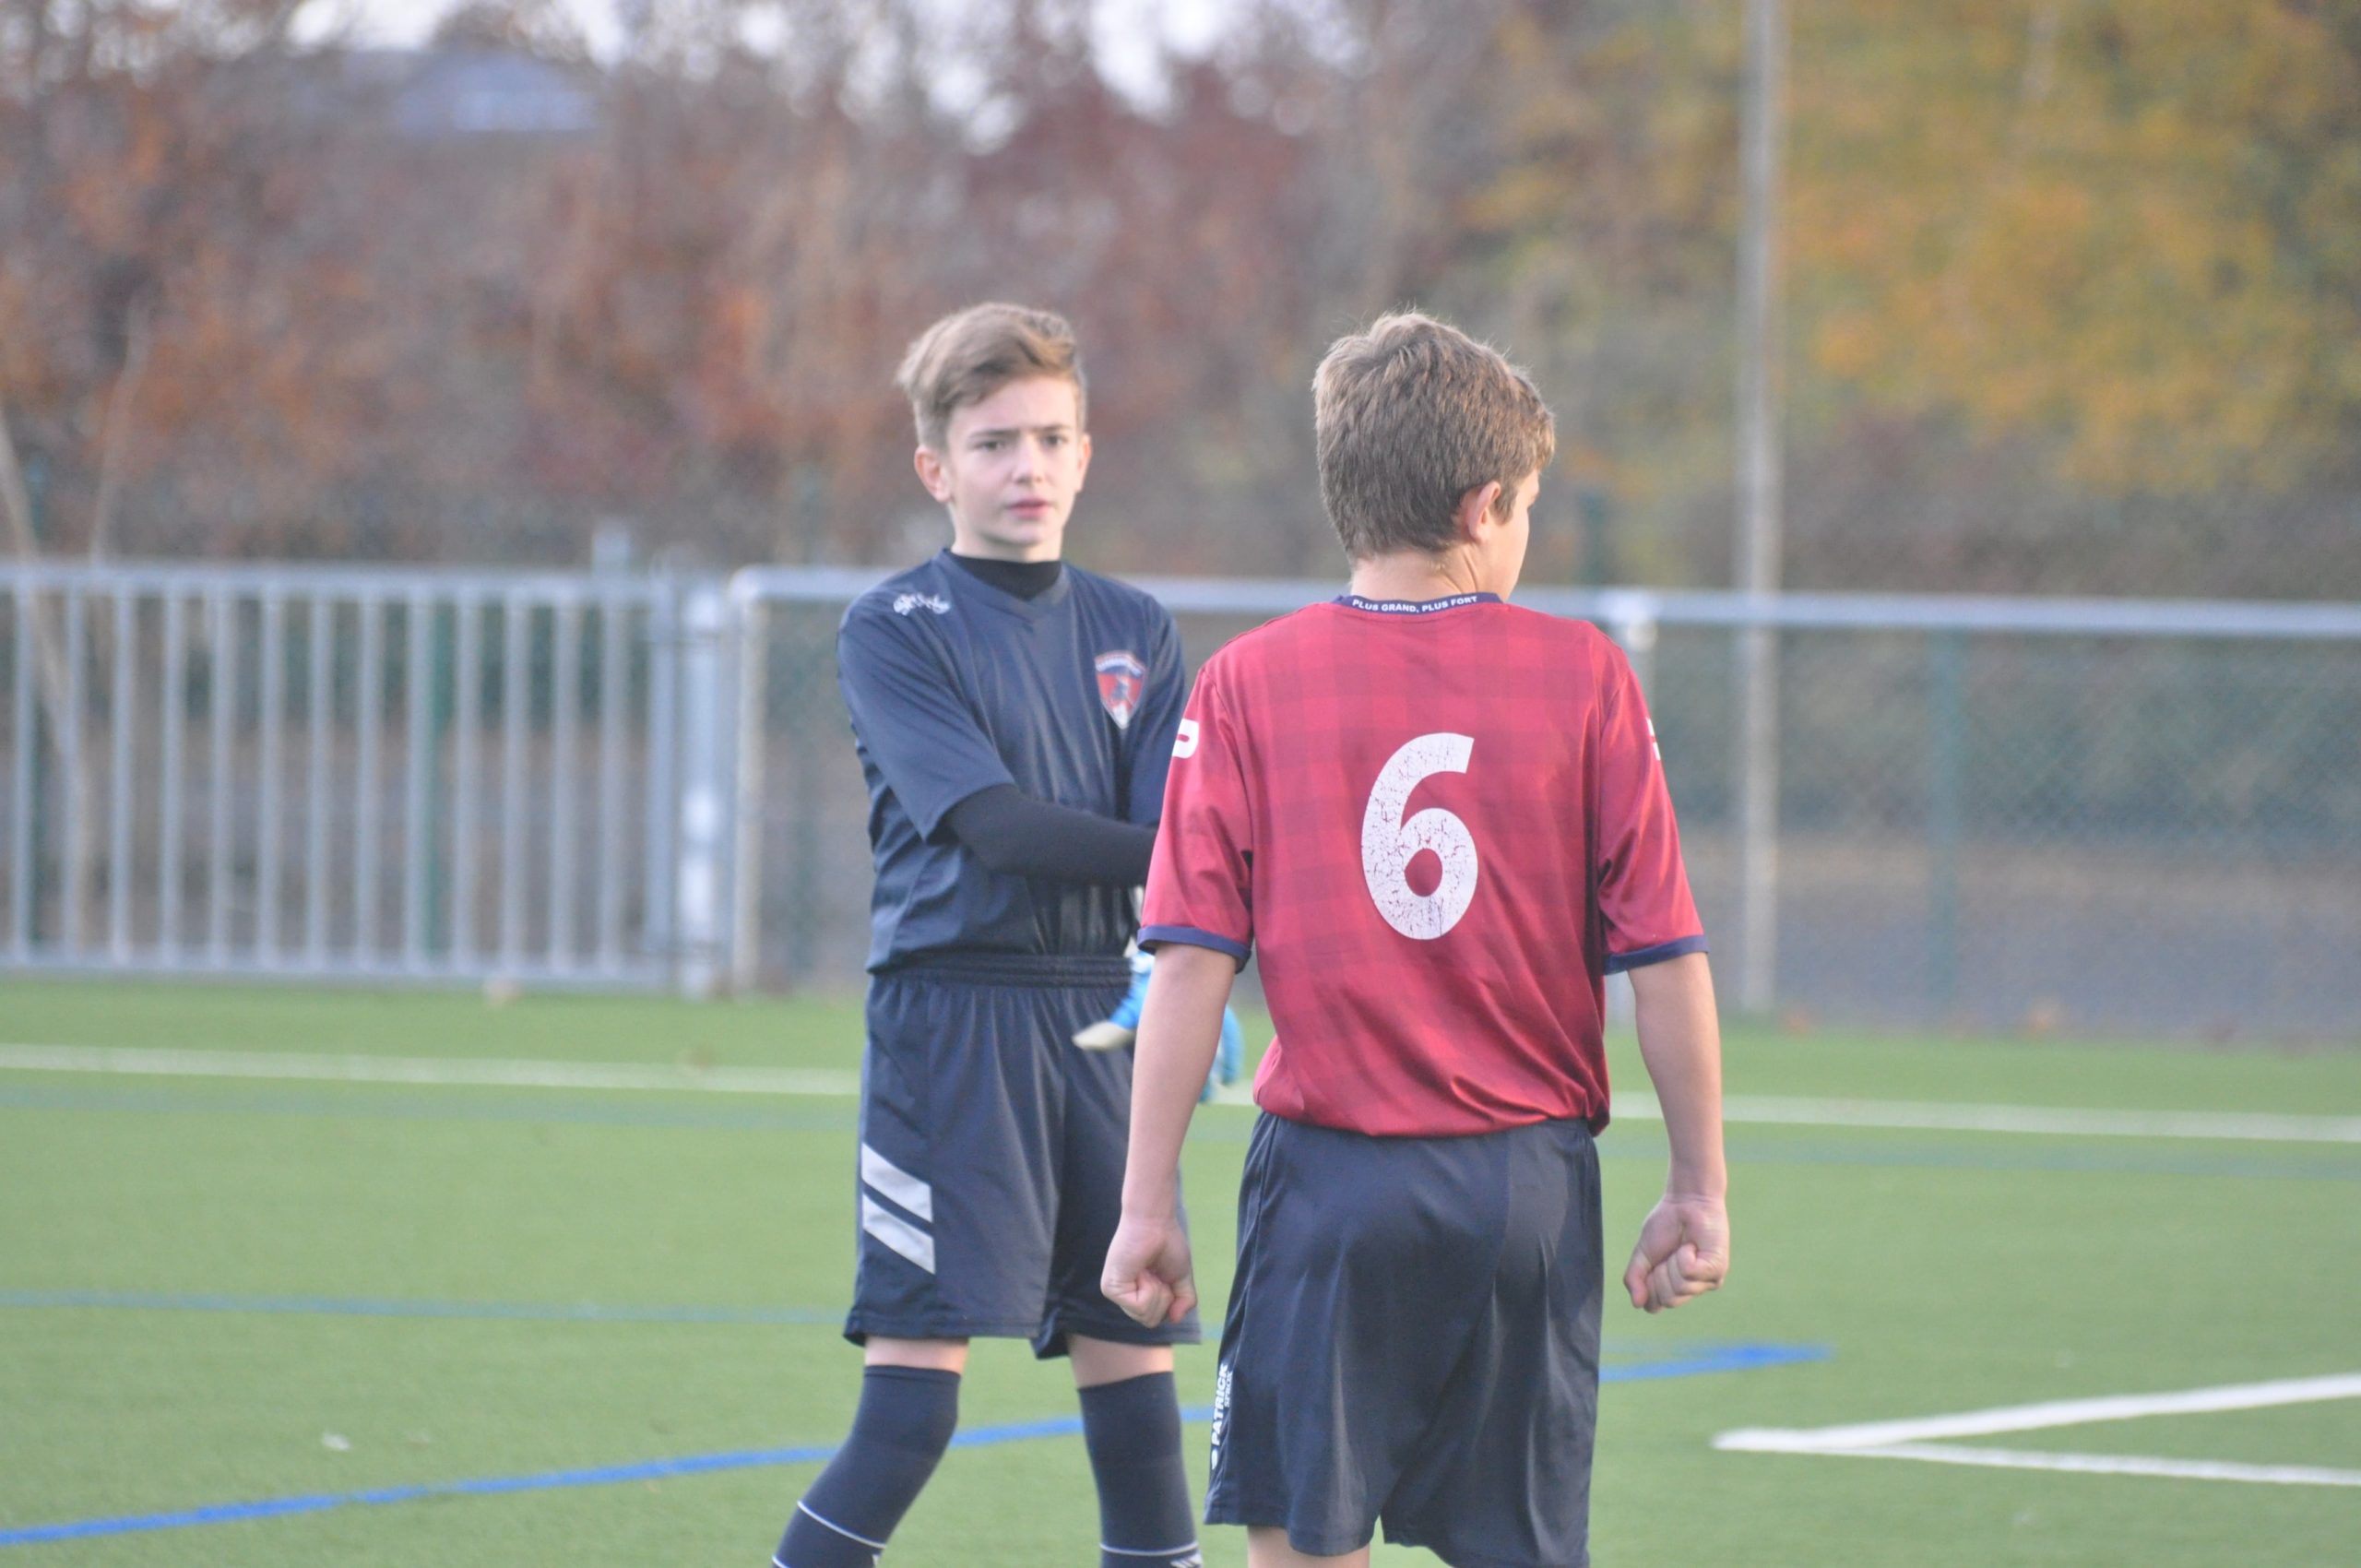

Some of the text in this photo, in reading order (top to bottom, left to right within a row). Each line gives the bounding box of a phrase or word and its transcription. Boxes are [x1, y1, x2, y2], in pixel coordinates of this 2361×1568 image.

[1352, 596, 1477, 613] PLUS GRAND, PLUS FORT
[1361, 732, 1478, 940] 6
[1211, 1362, 1228, 1446] PATRICK
